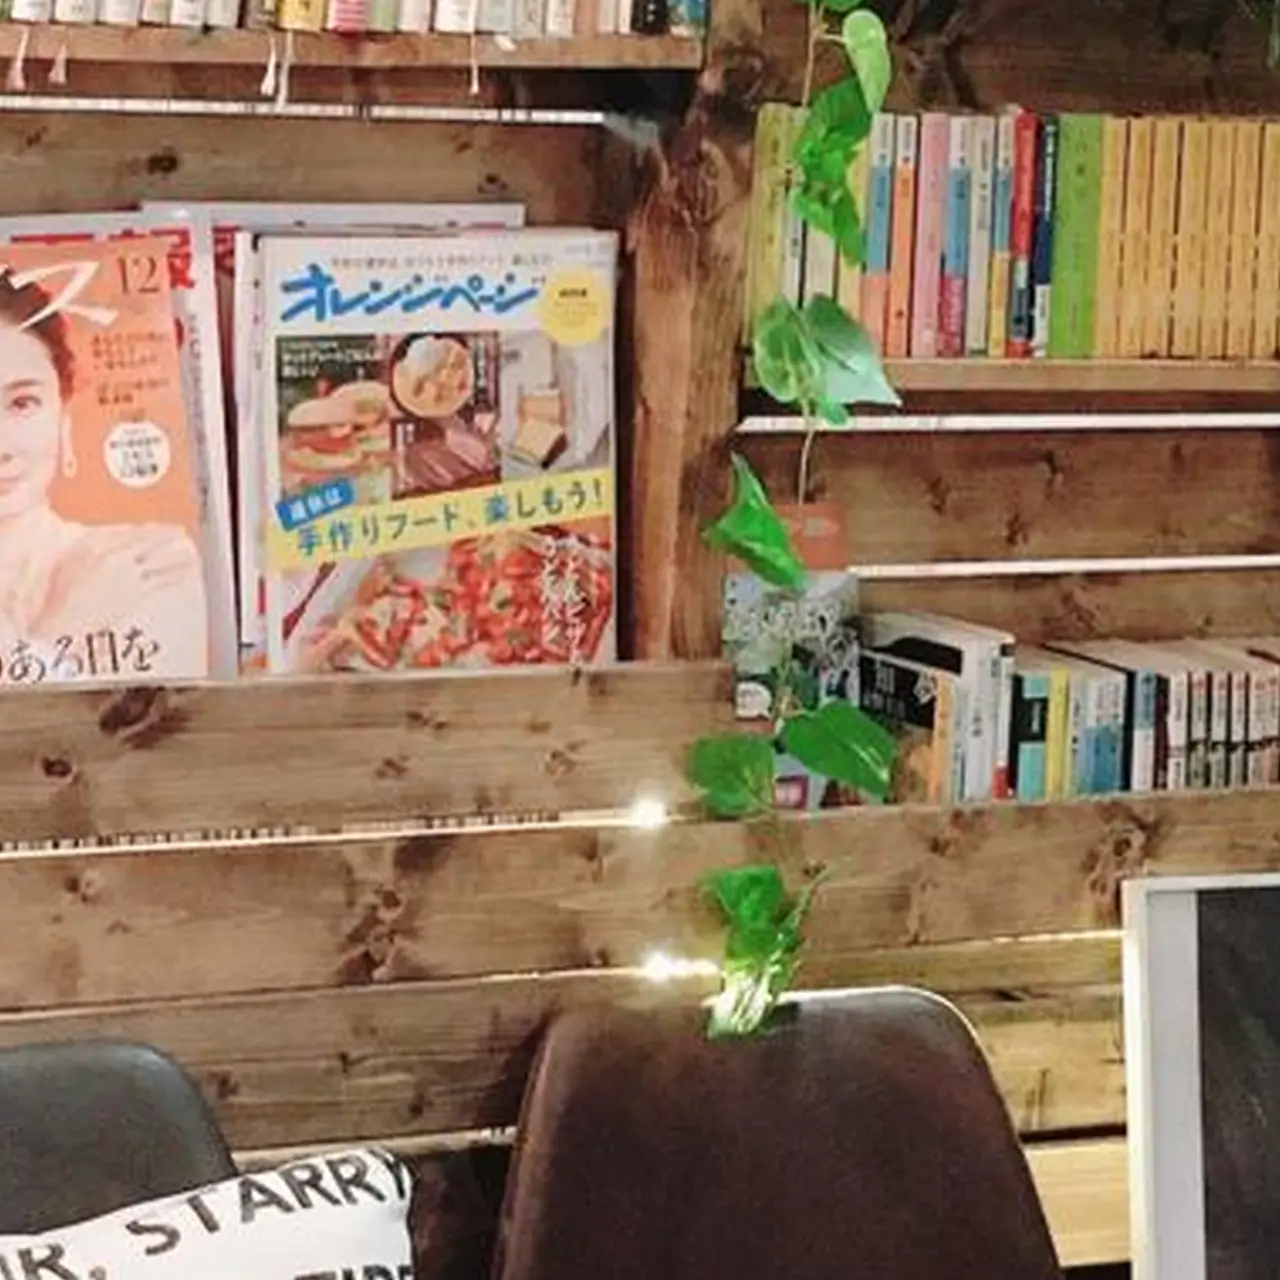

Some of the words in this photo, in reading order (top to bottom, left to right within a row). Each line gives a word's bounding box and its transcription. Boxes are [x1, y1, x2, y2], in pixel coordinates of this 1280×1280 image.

[117, 255, 161, 295] 12
[281, 263, 539, 321] オレンジページ
[126, 1145, 418, 1257] STARRY
